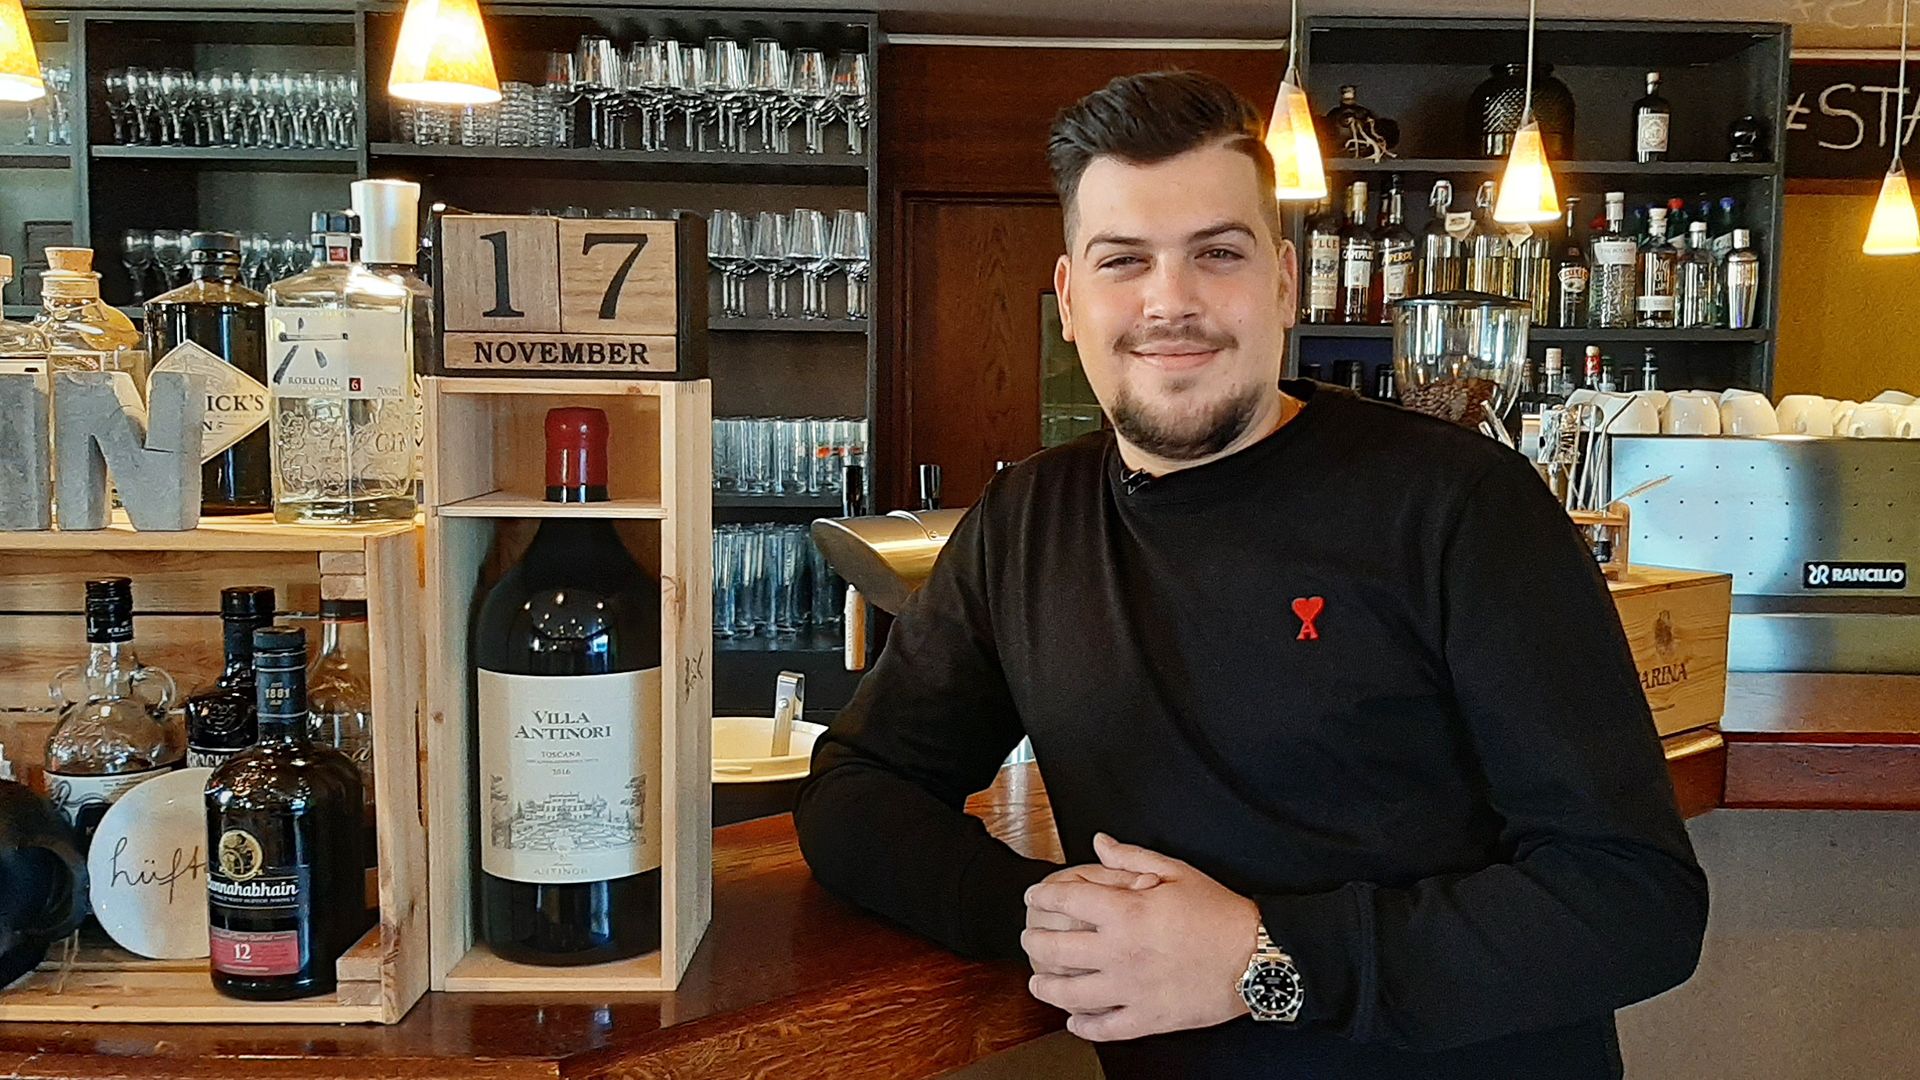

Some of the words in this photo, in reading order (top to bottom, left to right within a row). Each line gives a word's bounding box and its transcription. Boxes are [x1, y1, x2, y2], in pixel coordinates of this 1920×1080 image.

[474, 341, 650, 365] NOVEMBER
[288, 376, 316, 386] ROKU
[318, 376, 338, 386] GIN
[1831, 567, 1905, 583] RANCILIO
[265, 687, 291, 699] 1881
[534, 711, 590, 724] VILLA
[515, 725, 611, 740] ANTINORI
[233, 943, 252, 960] 12
